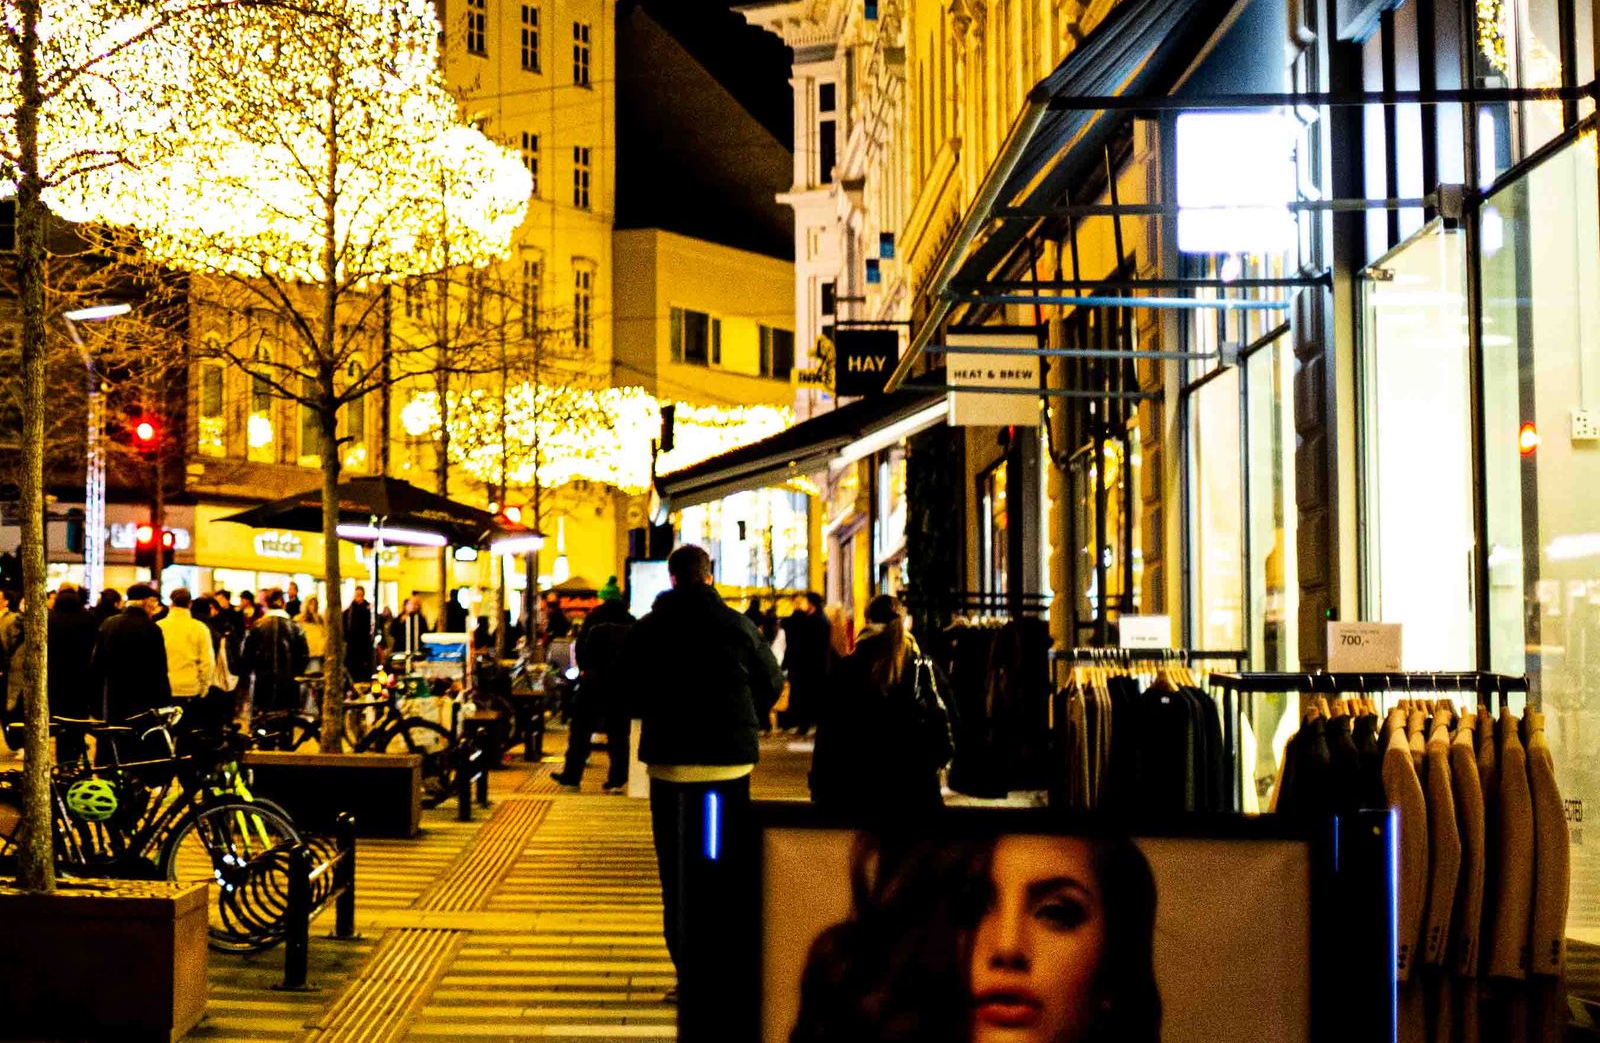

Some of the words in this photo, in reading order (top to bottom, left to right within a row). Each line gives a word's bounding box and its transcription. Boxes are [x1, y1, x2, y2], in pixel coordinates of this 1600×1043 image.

[848, 356, 886, 372] HAY
[954, 370, 982, 379] HEAT
[1000, 370, 1032, 380] BREW
[1341, 635, 1369, 646] 700,-
